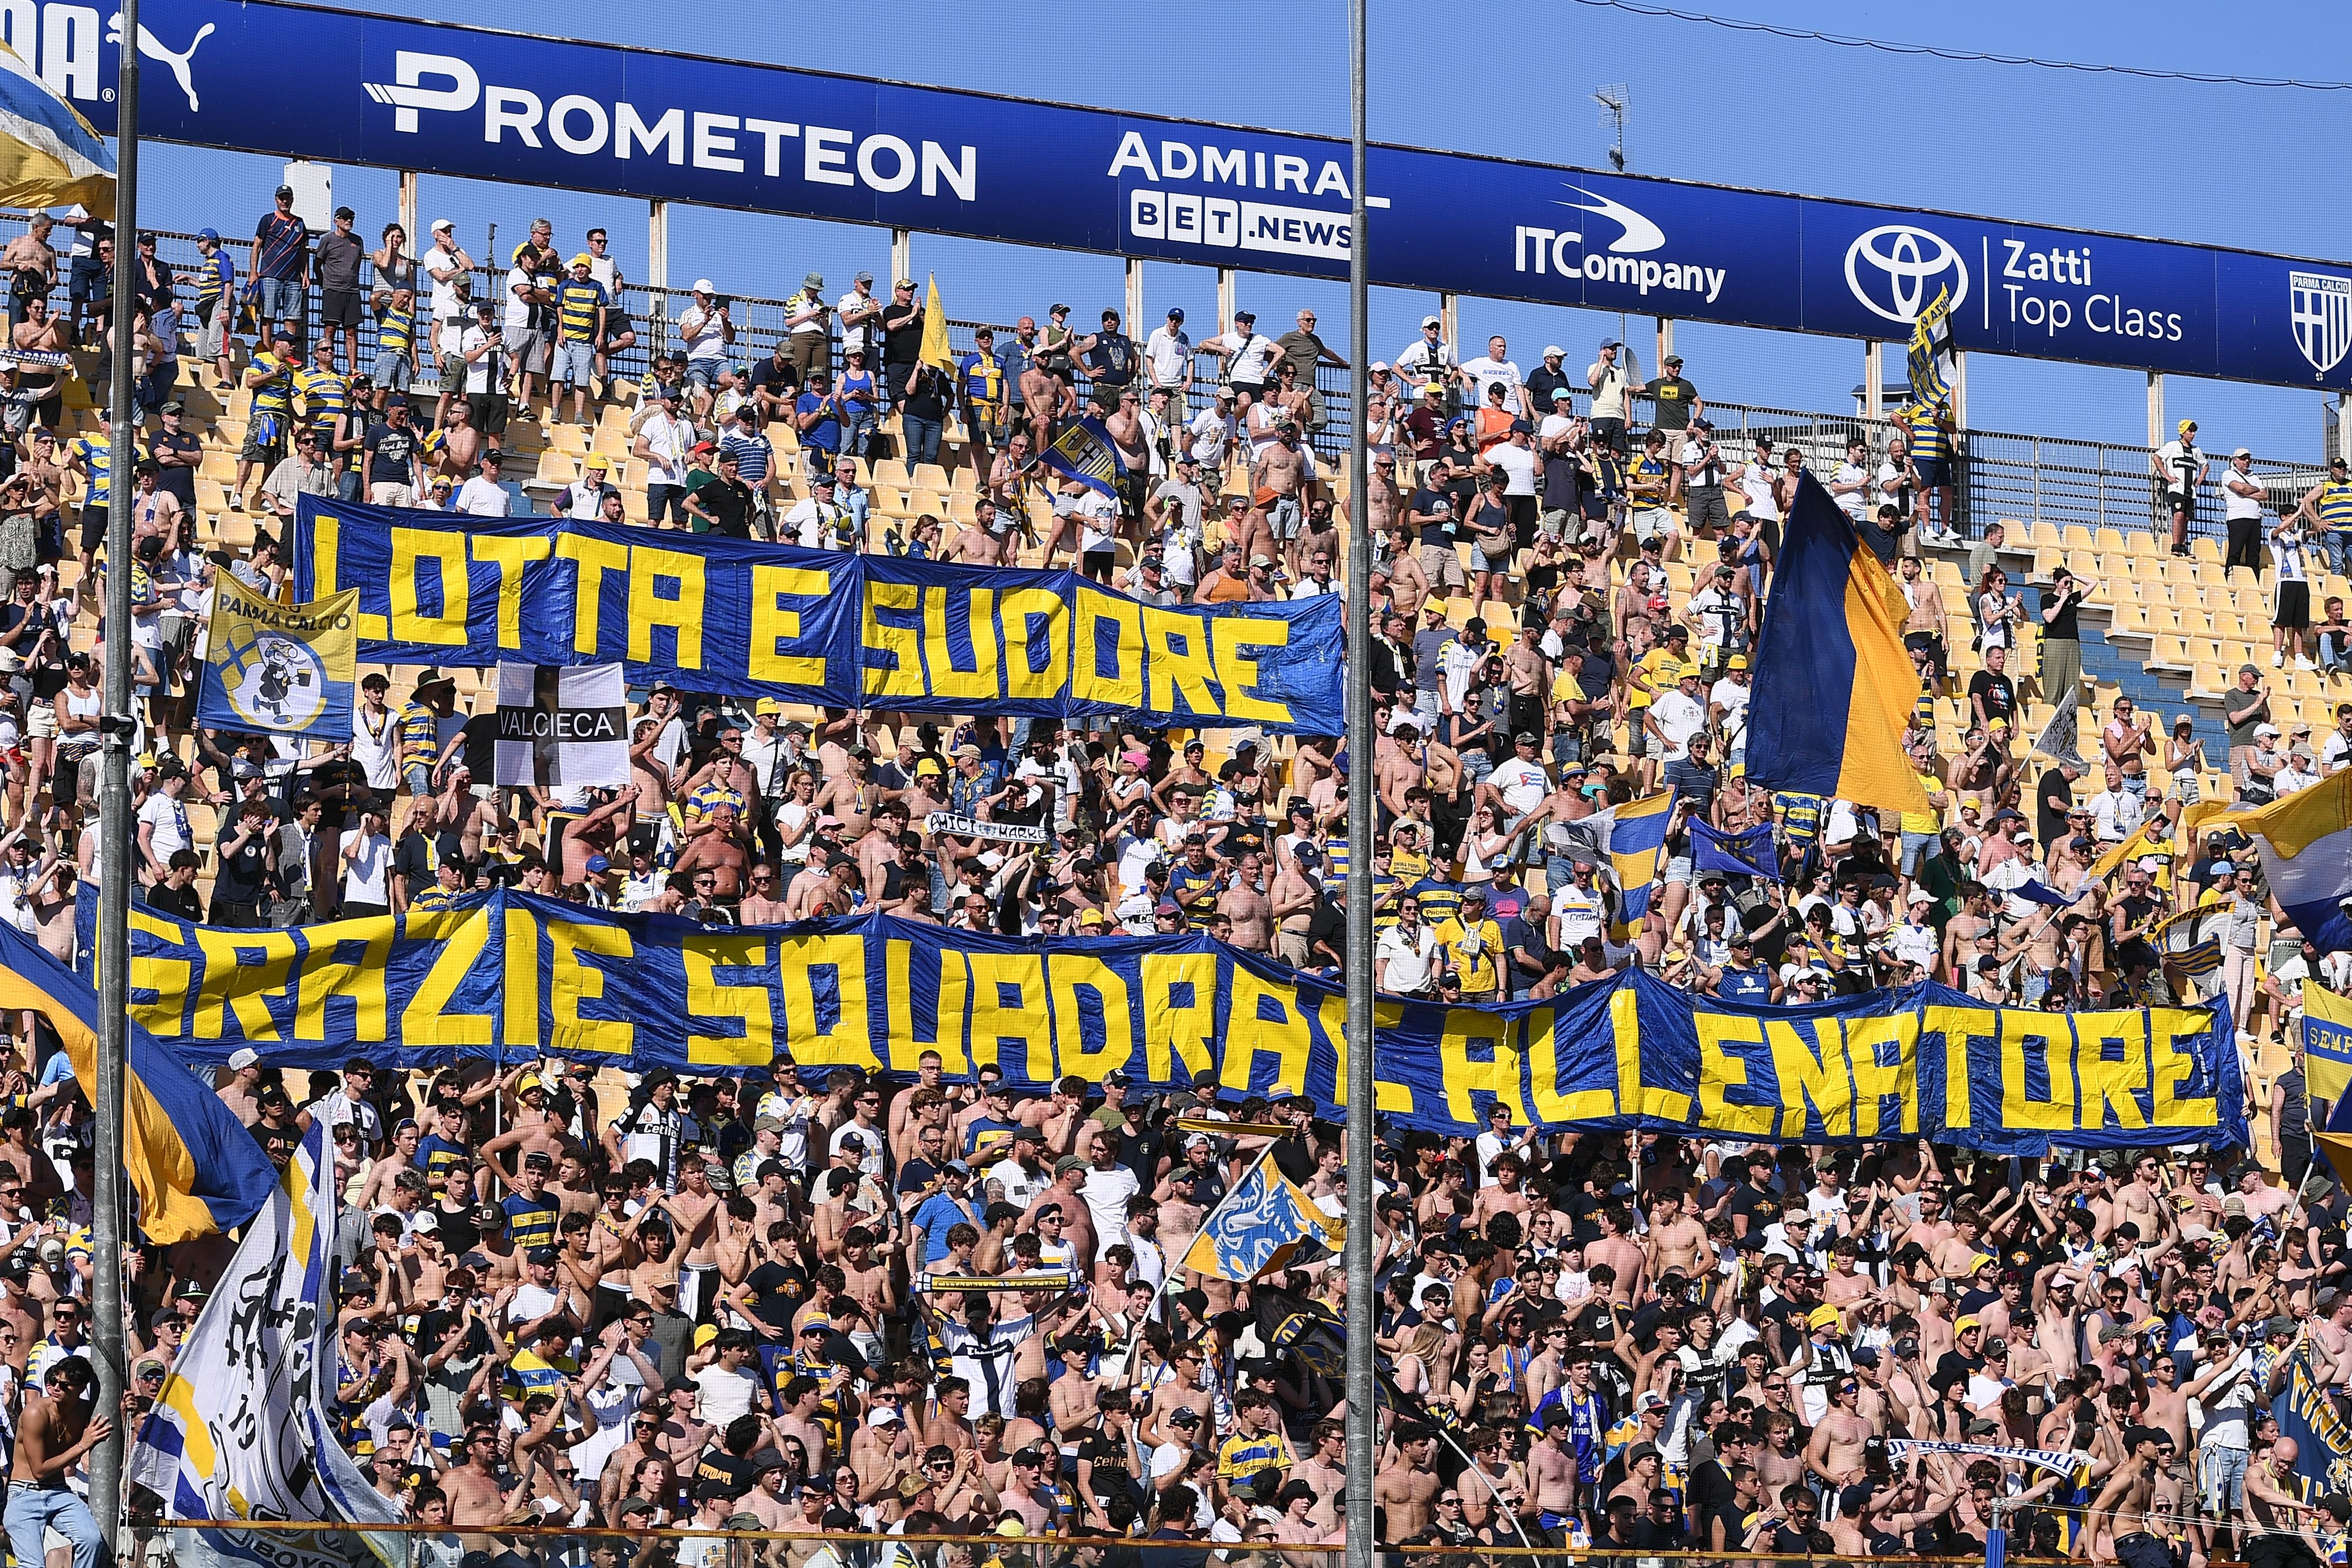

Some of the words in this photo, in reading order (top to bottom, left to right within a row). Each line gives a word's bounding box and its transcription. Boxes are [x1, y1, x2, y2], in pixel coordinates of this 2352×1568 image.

[362, 50, 977, 202] PROMETEON
[1107, 130, 1391, 209] ADMIRA
[1515, 225, 1726, 304] ITCompany
[2003, 239, 2092, 287] Zatti
[2293, 276, 2321, 290] PARMA
[2322, 279, 2349, 293] CALCIO
[2003, 283, 2072, 337] Top
[2084, 294, 2183, 342] Class
[219, 593, 279, 628] PARMA
[284, 613, 351, 631] CALCIO
[313, 515, 706, 670] LOTTA
[749, 564, 829, 686] E
[862, 580, 1295, 722] SUDORE
[500, 711, 615, 738] VALCIECA
[93, 897, 634, 1055] GRAZIE
[682, 934, 1314, 1091] SQUADRA
[1440, 988, 2219, 1138] ALLENATORE
[967, 1345, 1009, 1356] Champion
